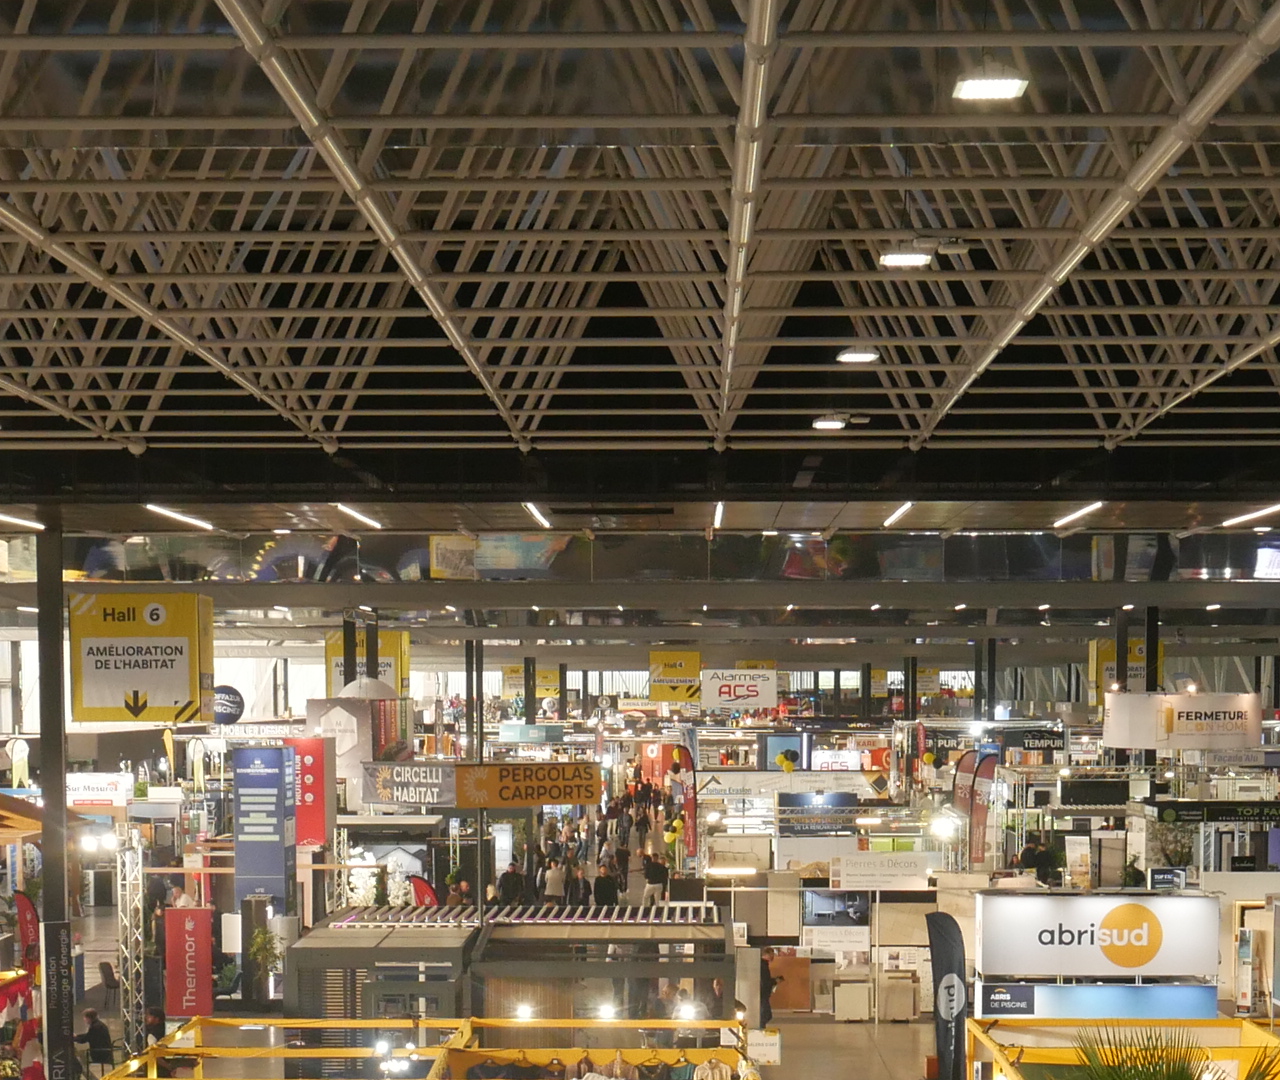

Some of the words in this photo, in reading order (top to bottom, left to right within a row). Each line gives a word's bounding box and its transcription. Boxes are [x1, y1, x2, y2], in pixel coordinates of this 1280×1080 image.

[103, 607, 136, 622] Hall
[149, 608, 160, 621] 6
[86, 644, 184, 657] AMÉLIORATION
[95, 659, 111, 670] DE
[114, 659, 176, 670] L'HABITAT
[710, 672, 770, 682] Alarmes
[718, 684, 760, 698] ACS
[1177, 710, 1249, 721] FERMETURE
[222, 724, 259, 736] MOBILIER
[261, 724, 290, 736] DESIGN
[1024, 739, 1064, 748] TEMPUR
[393, 766, 442, 784] CIRCELLI
[499, 766, 594, 783] PERGOLAS
[393, 787, 439, 804] HABITAT
[498, 784, 595, 801] CARPORTS
[1237, 808, 1260, 816] TOP
[845, 859, 877, 869] Pierres
[887, 858, 918, 869] Décors
[1038, 922, 1149, 946] abrisud
[60, 928, 68, 974] d'énergie
[183, 937, 197, 1010] Thermor
[49, 956, 57, 1009] Production
